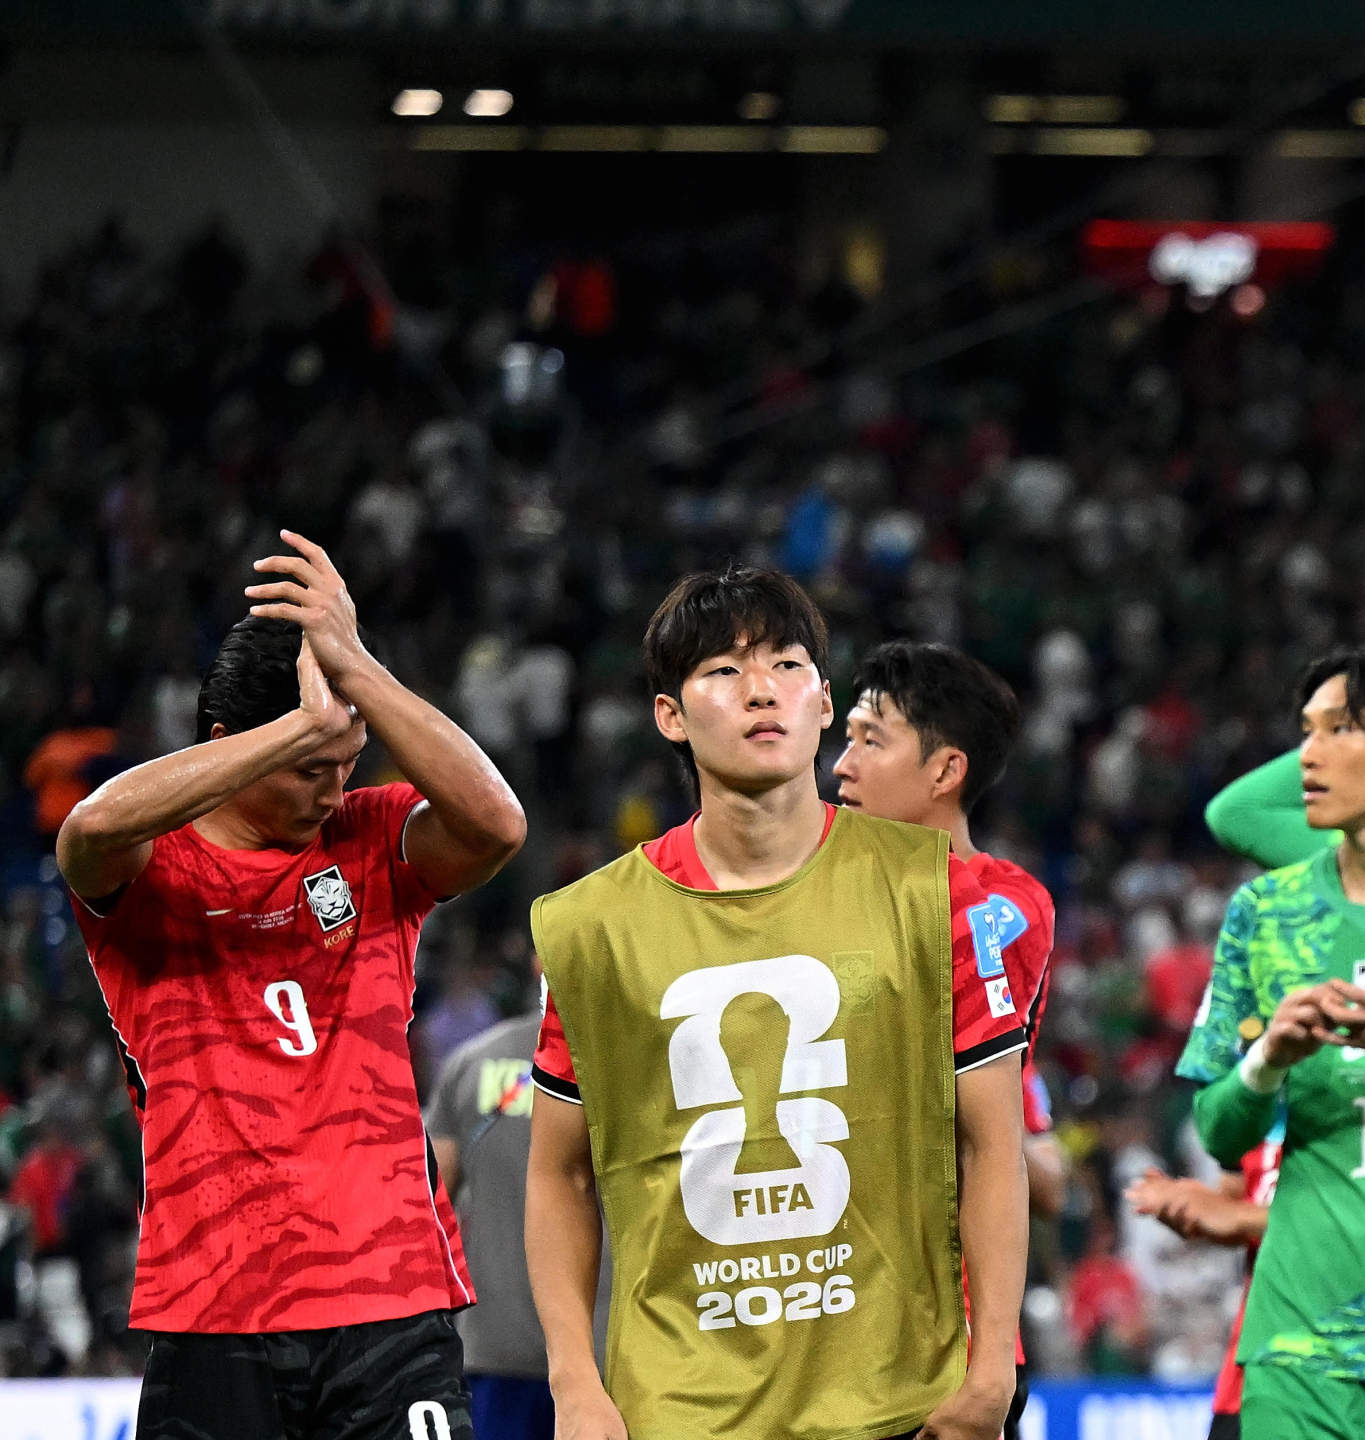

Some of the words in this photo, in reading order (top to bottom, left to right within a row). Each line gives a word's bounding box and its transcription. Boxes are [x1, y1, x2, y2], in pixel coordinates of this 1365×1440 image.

[323, 925, 355, 949] KORE
[263, 980, 318, 1057] 9
[733, 1181, 814, 1218] FIFA
[693, 1252, 801, 1286] WORLD
[806, 1242, 853, 1274] CUP
[697, 1274, 856, 1332] 2026
